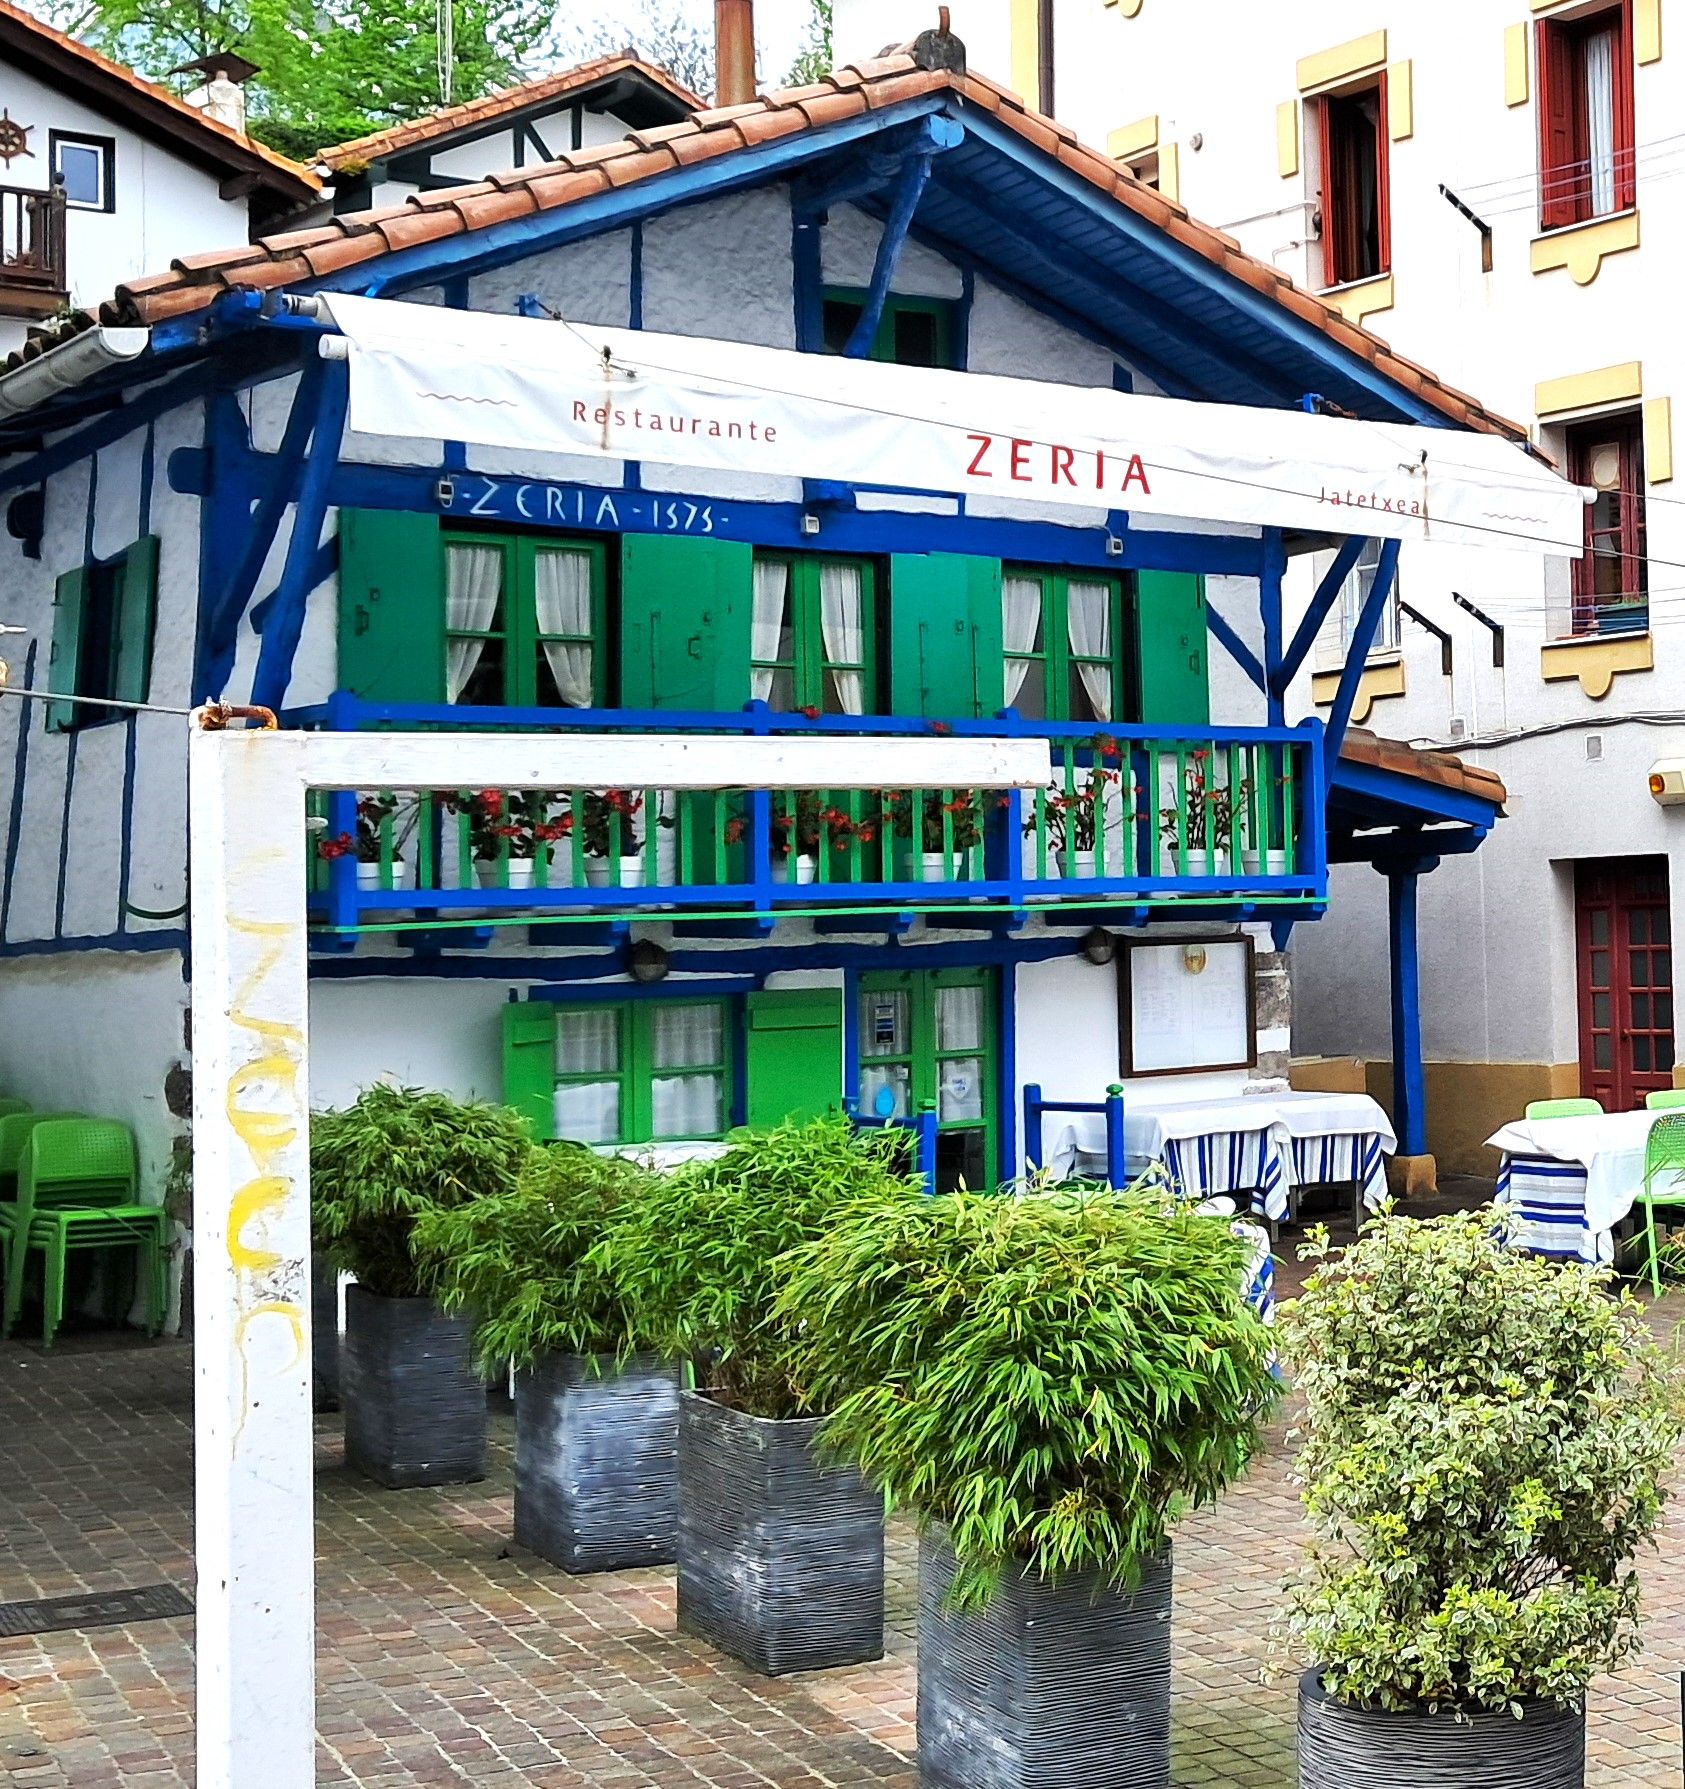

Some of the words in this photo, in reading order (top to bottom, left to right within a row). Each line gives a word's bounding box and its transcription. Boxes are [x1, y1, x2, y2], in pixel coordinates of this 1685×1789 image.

[573, 400, 777, 442] Restaurante
[966, 434, 1151, 495] ZERIA
[1316, 486, 1420, 516] Jatetxea
